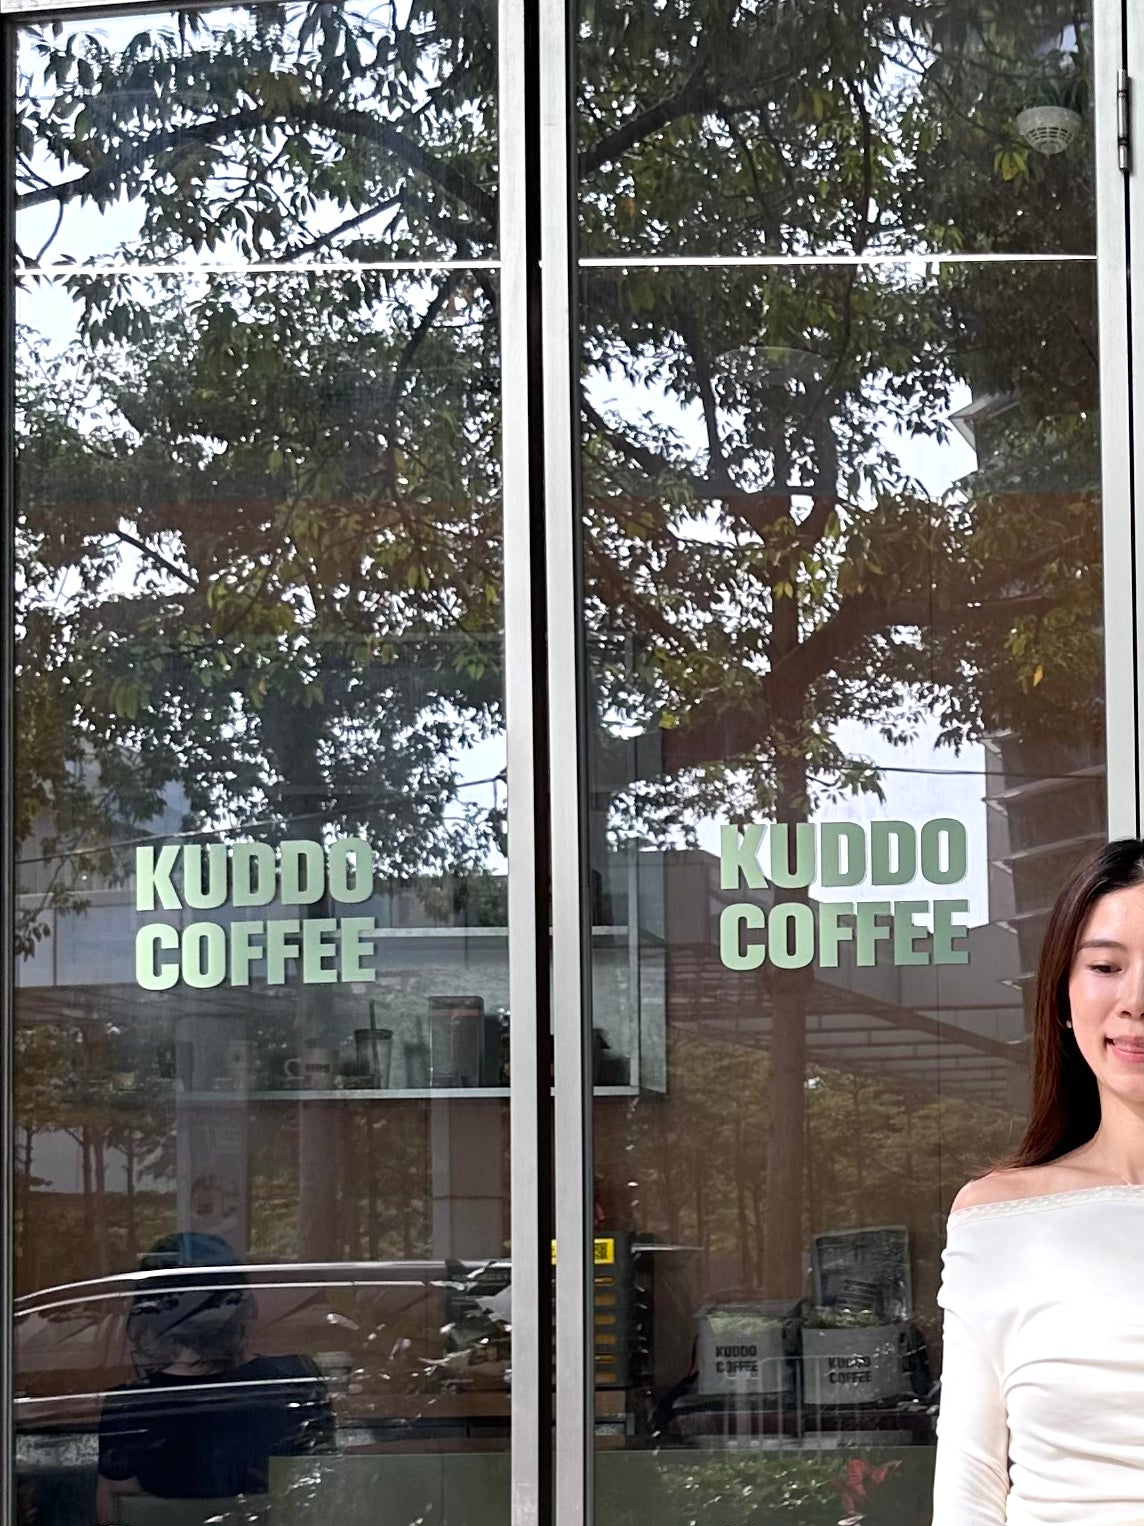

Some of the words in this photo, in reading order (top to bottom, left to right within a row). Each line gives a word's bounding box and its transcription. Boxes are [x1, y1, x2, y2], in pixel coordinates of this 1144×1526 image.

[136, 837, 374, 911] KUDDO
[720, 818, 967, 890] KUDDO
[136, 917, 375, 990] COFFEE
[720, 900, 969, 970] COFFEE
[715, 1345, 757, 1357] KUDDO
[716, 1361, 758, 1373] COFFEE
[829, 1371, 872, 1383] COFFEE
